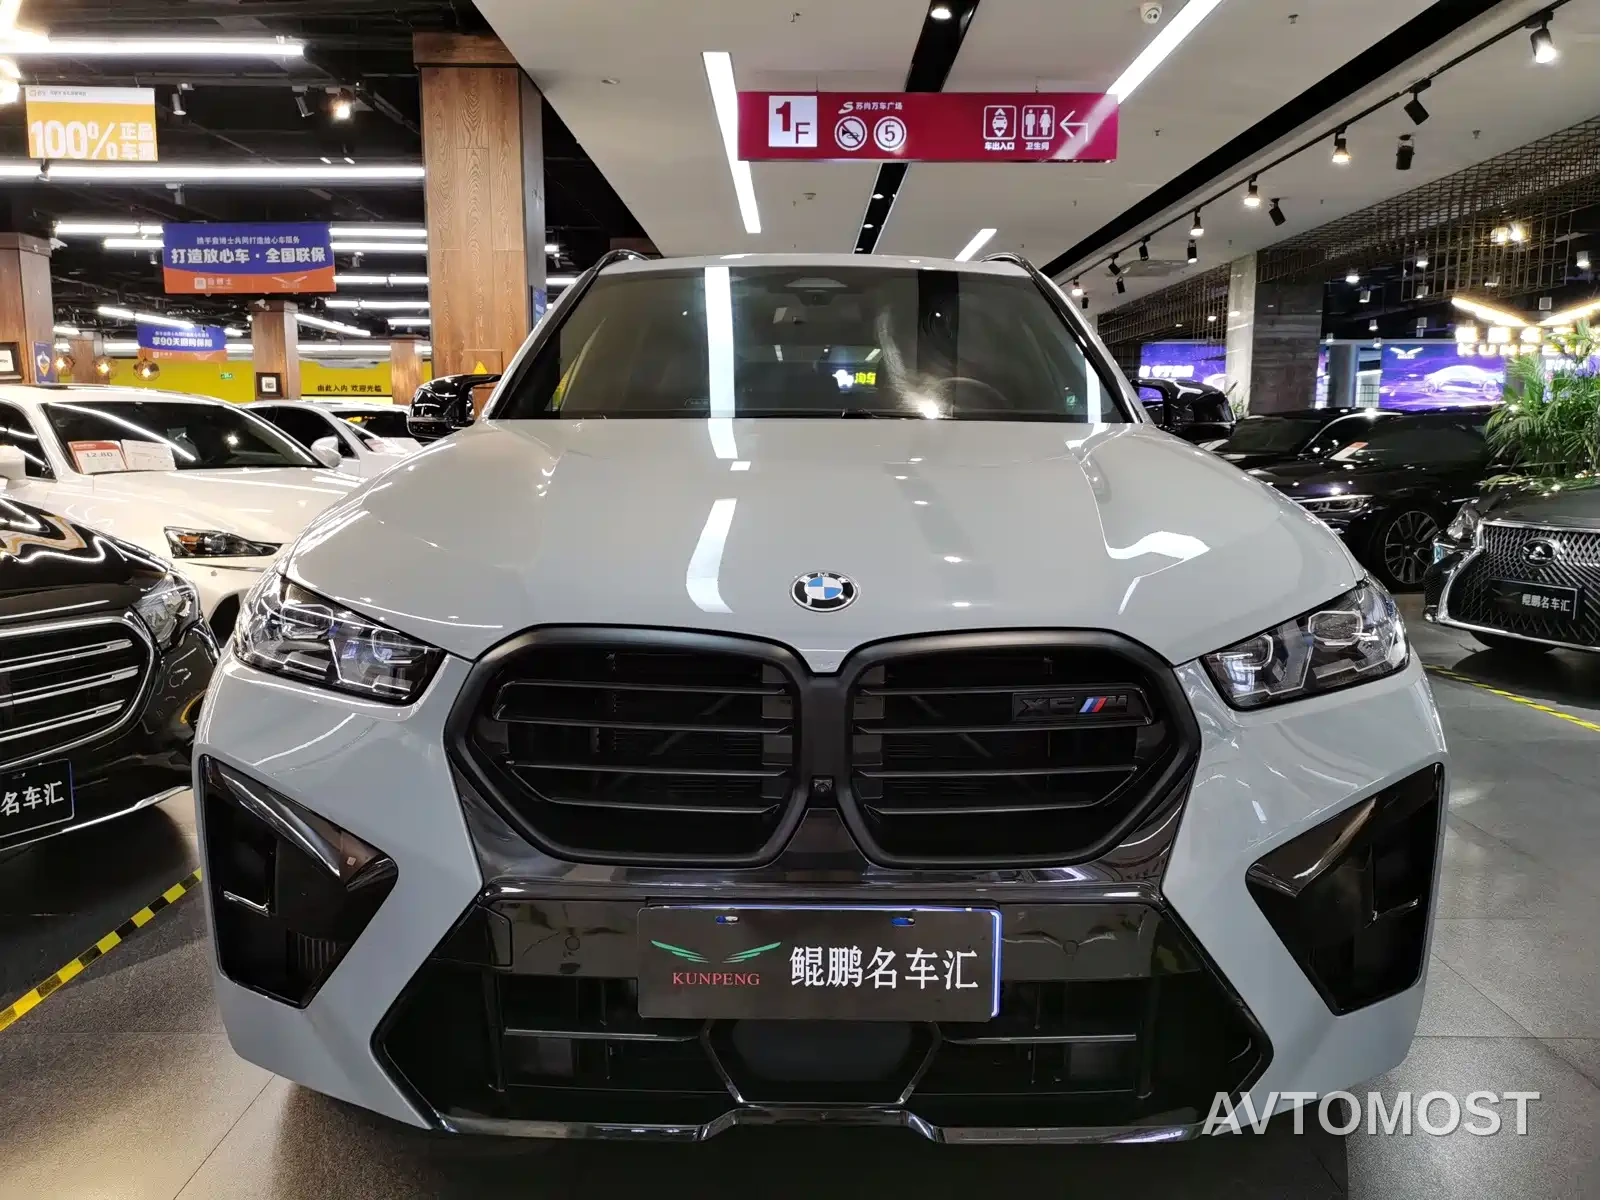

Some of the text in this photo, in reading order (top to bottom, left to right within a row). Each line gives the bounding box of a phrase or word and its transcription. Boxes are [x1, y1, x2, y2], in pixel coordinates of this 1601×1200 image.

[775, 101, 811, 144] 1F
[885, 124, 895, 142] 5
[30, 120, 118, 159] 100%
[984, 141, 1015, 151] 车出入口
[1025, 141, 1050, 151] 卫生间
[0, 781, 64, 816] 名车汇
[672, 972, 761, 986] KUNPENG
[790, 945, 979, 990] 鲲鹏名车汇
